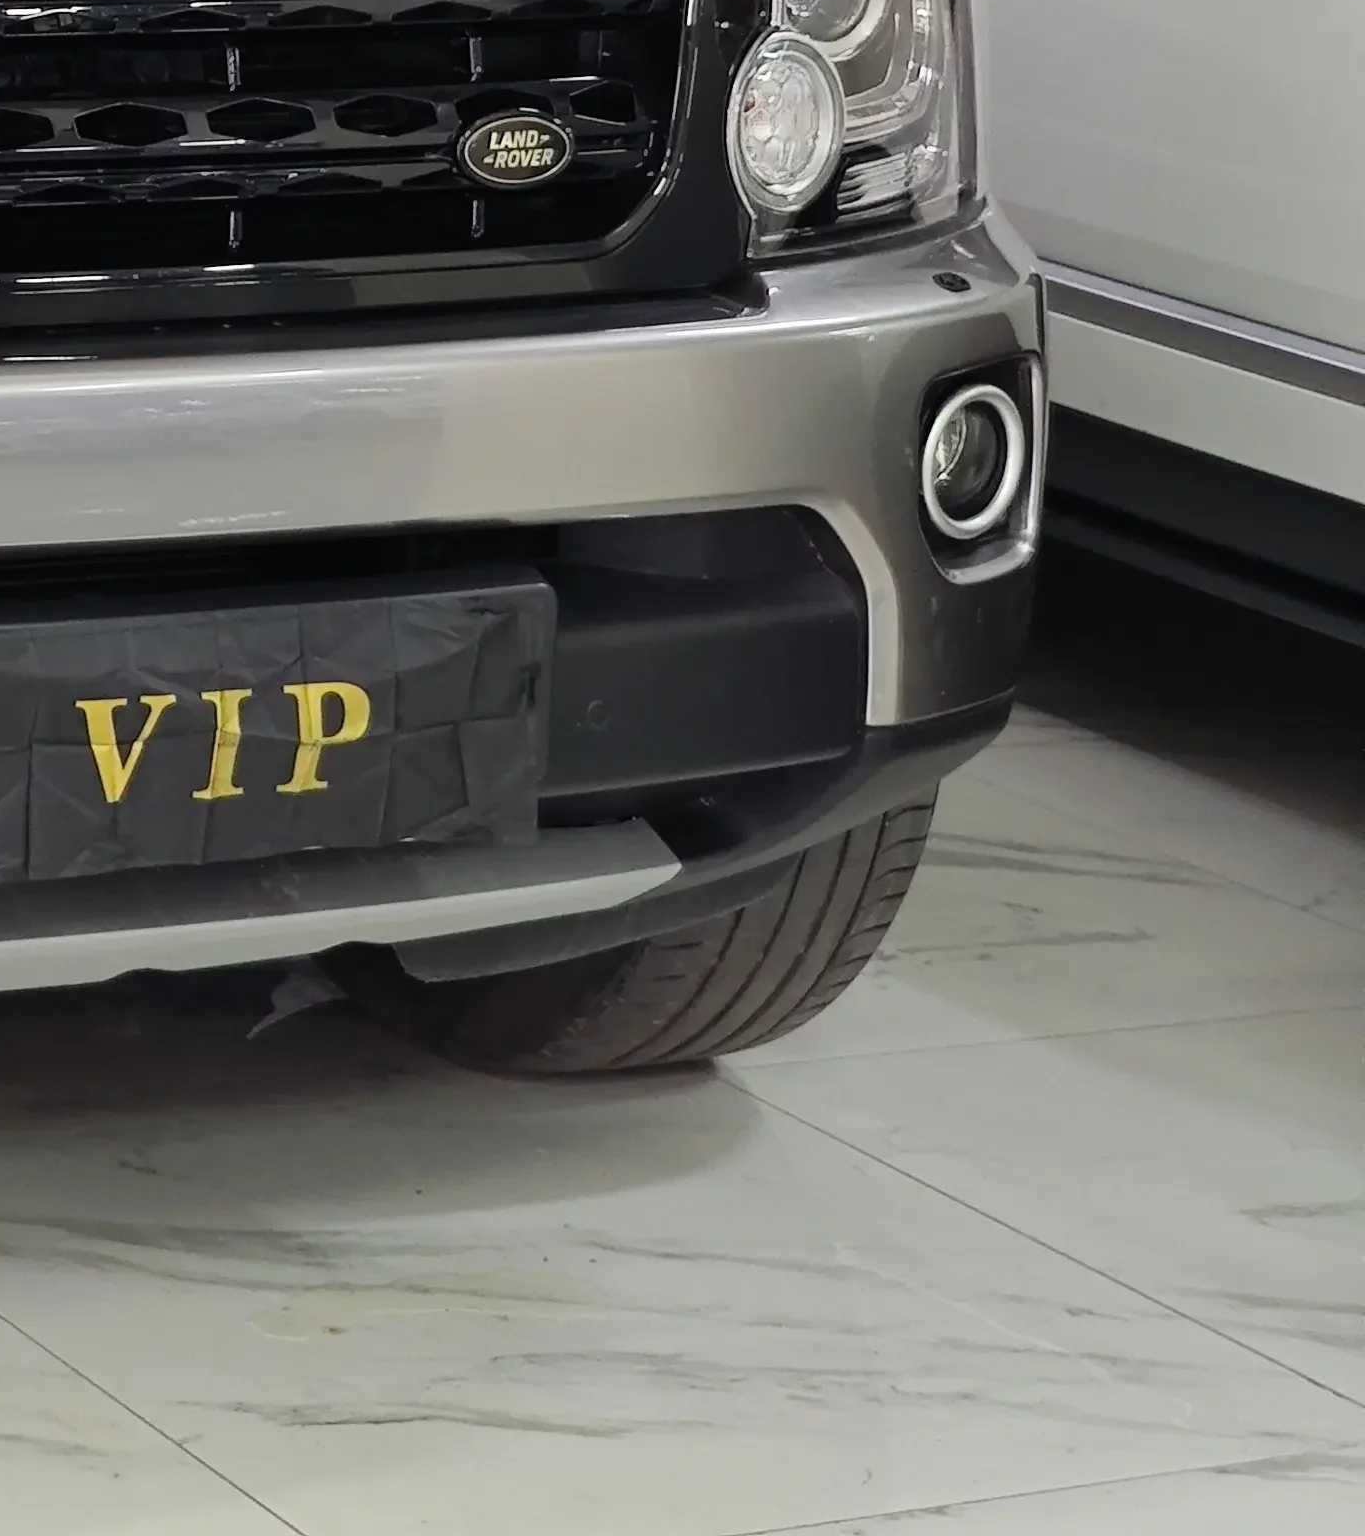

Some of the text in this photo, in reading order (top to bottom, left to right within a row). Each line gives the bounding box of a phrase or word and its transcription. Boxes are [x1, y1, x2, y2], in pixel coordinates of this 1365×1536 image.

[489, 129, 540, 150] LAND
[493, 147, 556, 169] ROVER
[75, 680, 372, 803] VIP
